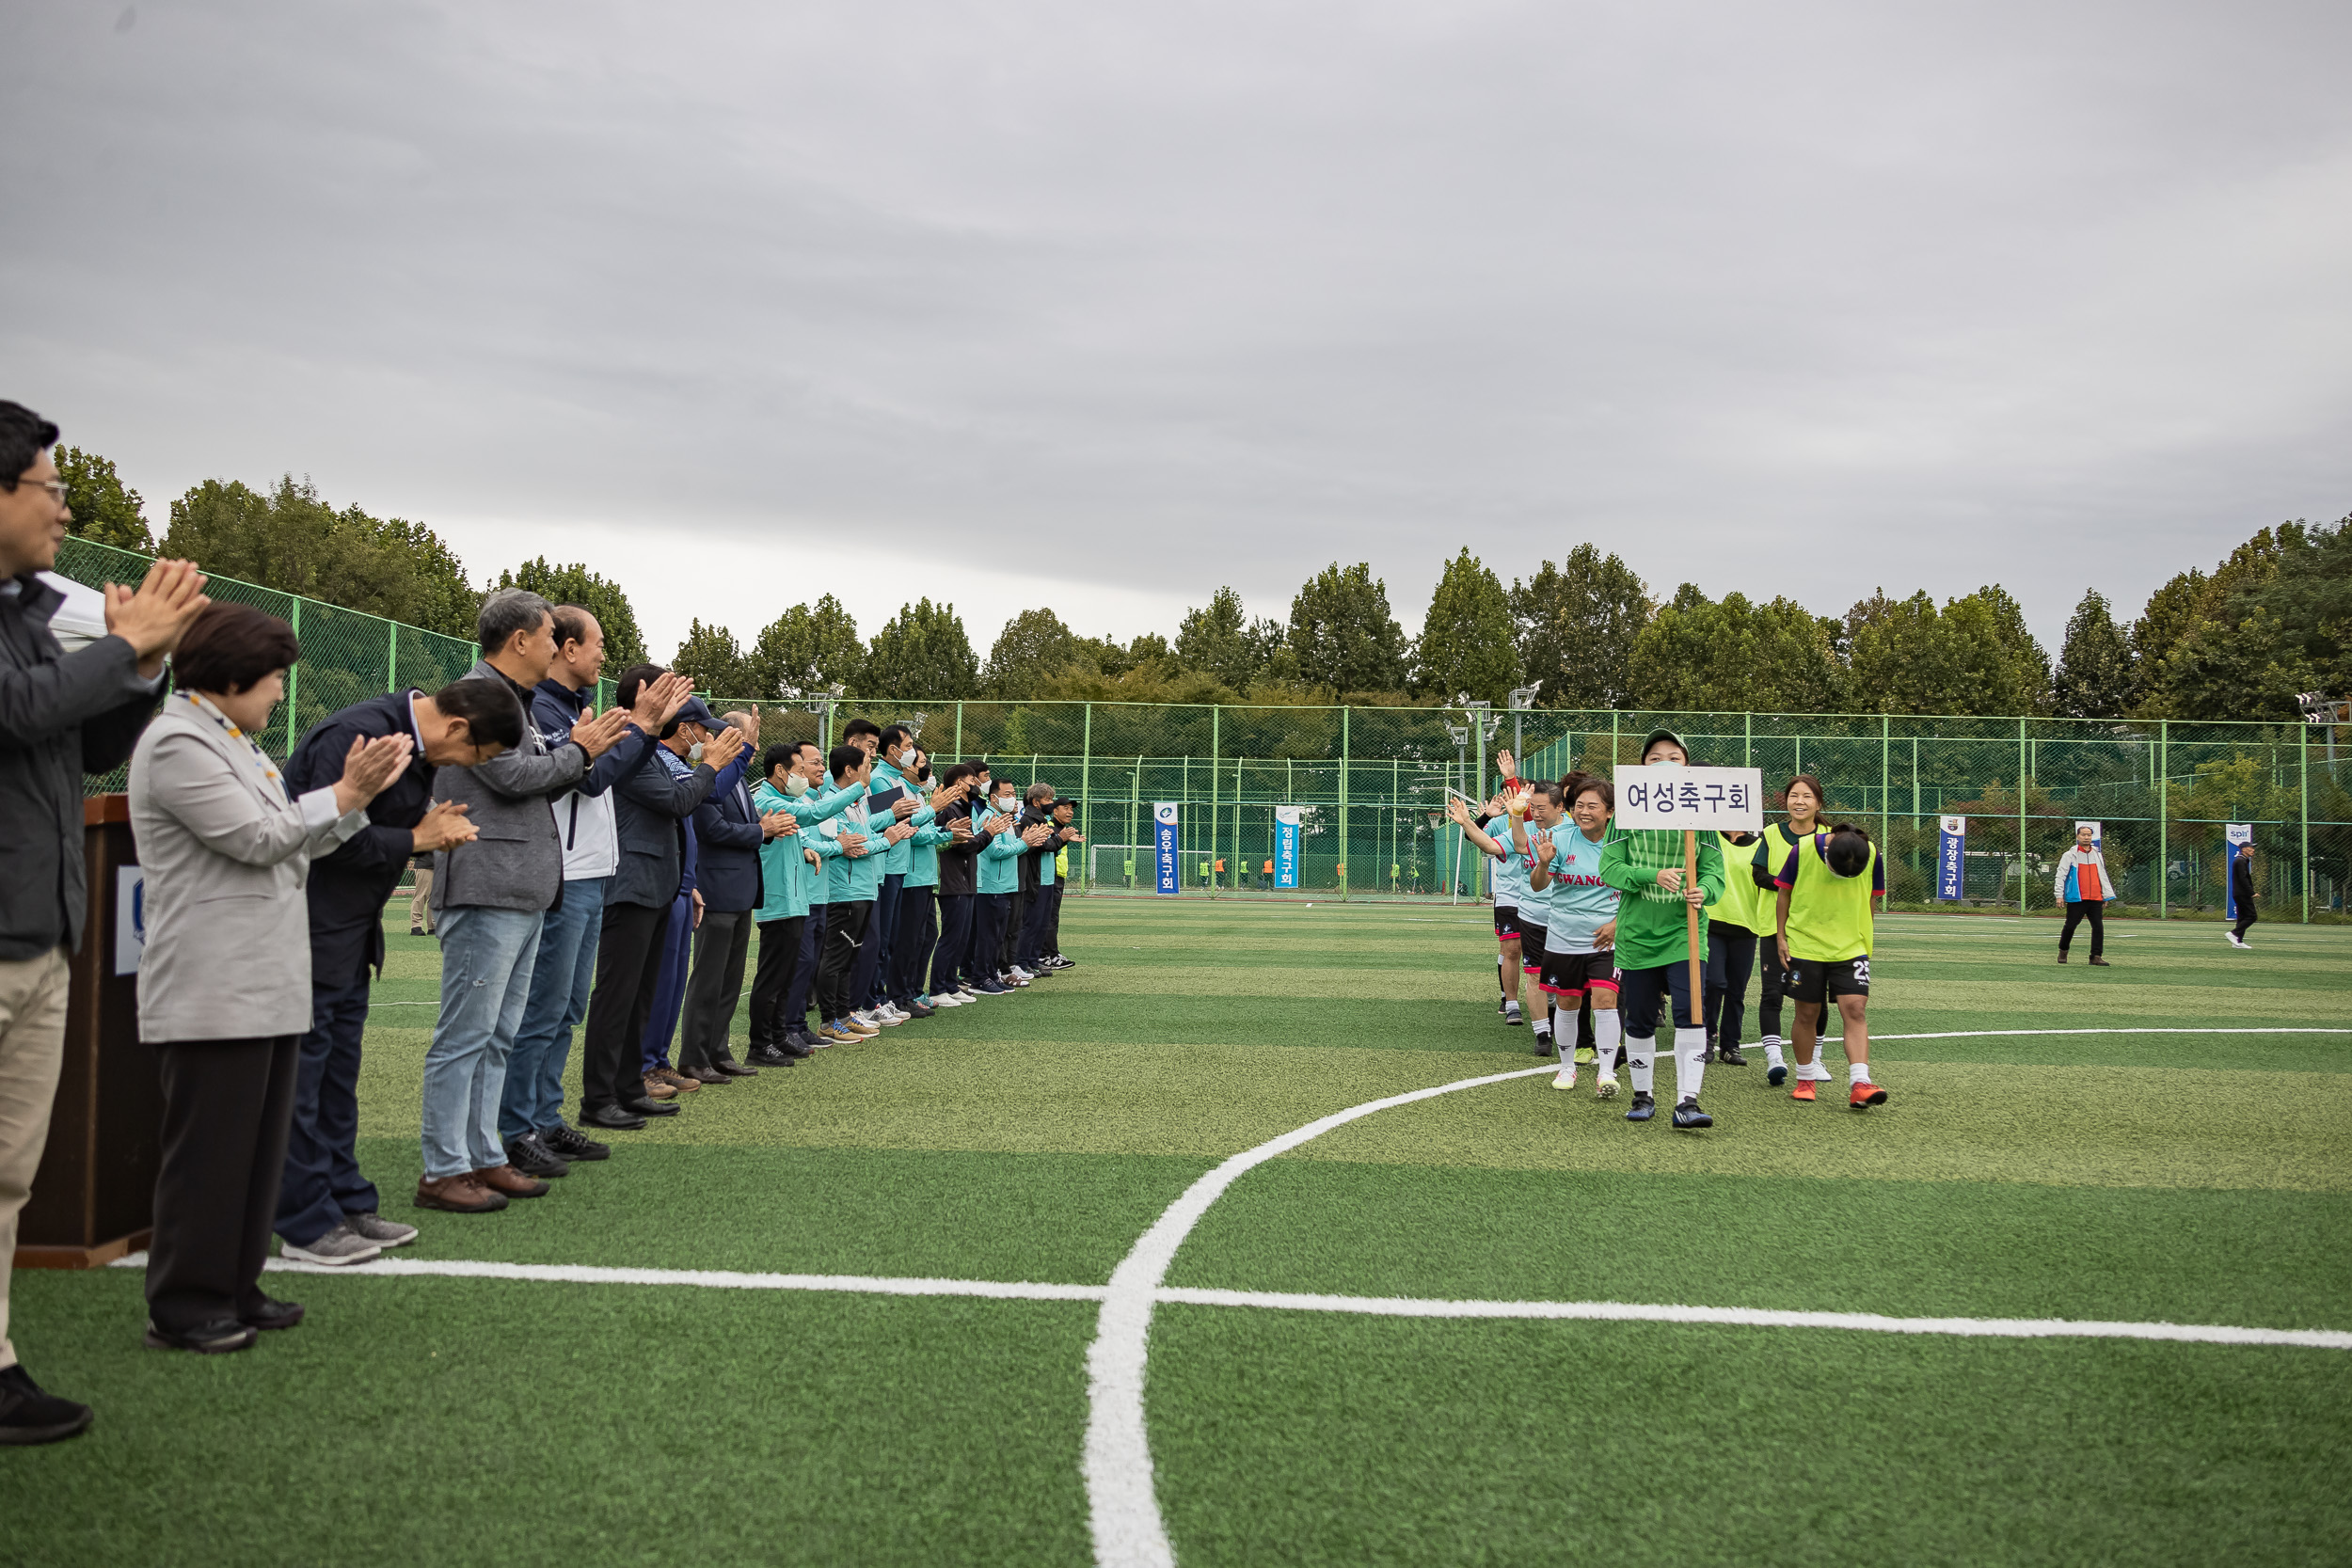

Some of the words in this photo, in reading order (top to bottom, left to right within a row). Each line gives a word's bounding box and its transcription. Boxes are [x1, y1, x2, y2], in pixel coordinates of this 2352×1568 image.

[1628, 783, 1749, 814] 여성축구회
[1161, 829, 1174, 889] 송우축구회
[1280, 827, 1293, 885] 정립축구회
[1557, 873, 1611, 887] GWANG
[1944, 837, 1959, 897] 광장축구회
